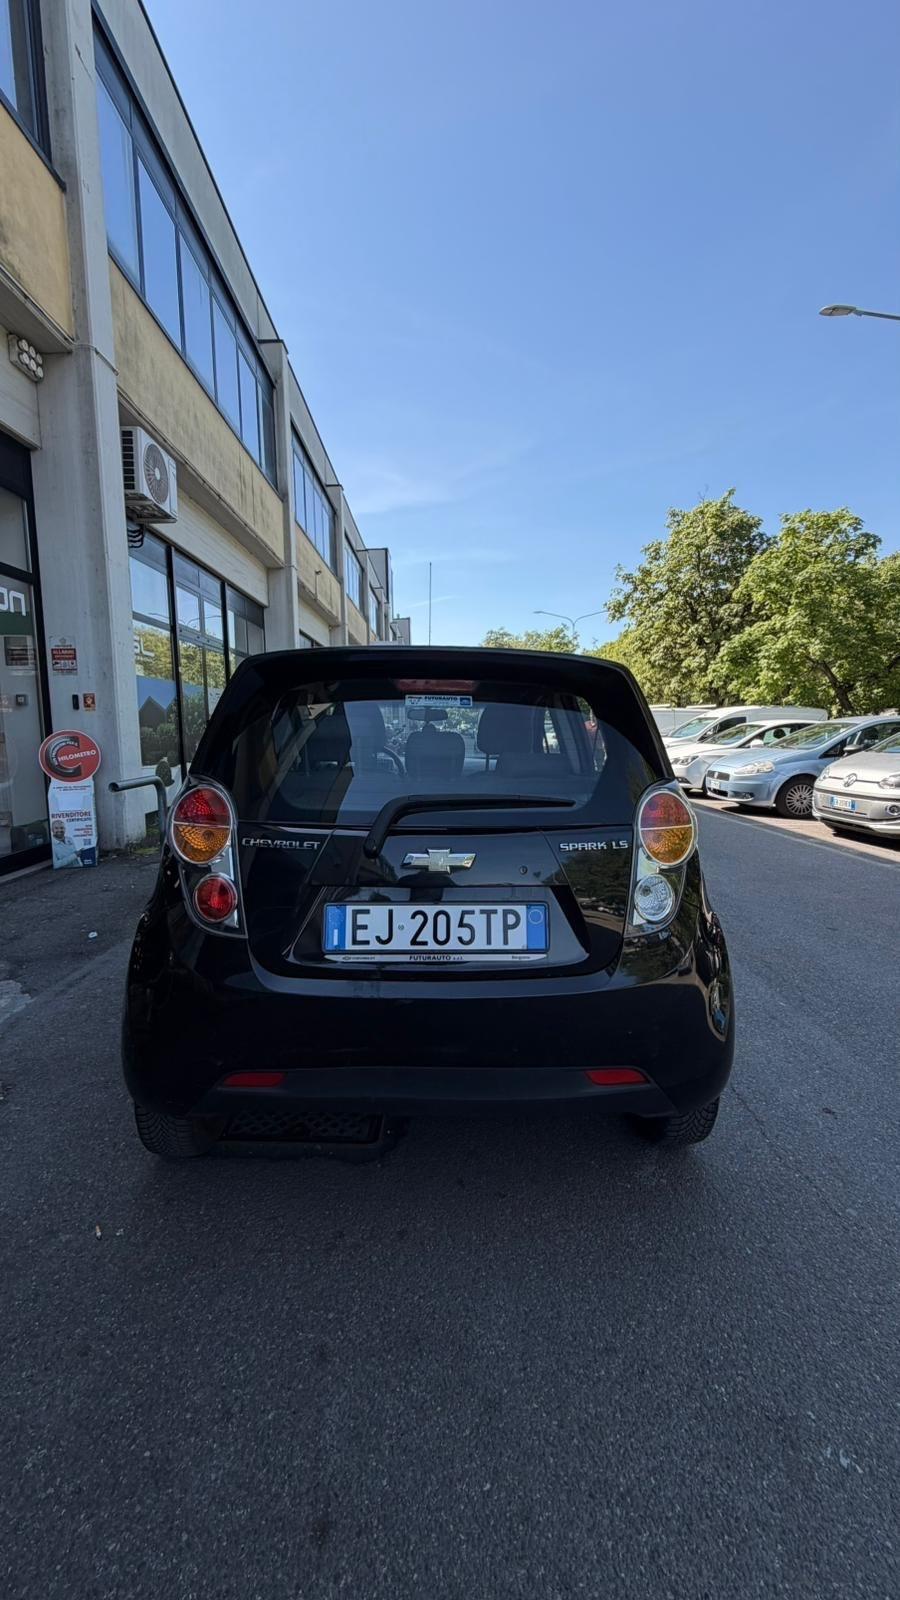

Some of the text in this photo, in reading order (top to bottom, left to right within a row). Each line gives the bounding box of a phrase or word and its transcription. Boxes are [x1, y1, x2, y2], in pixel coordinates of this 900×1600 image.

[51, 811, 91, 819] RIVENDITORE
[241, 838, 320, 849] CHEVROLET
[560, 840, 628, 851] SPARK LS
[351, 908, 521, 946] EJ 205TP
